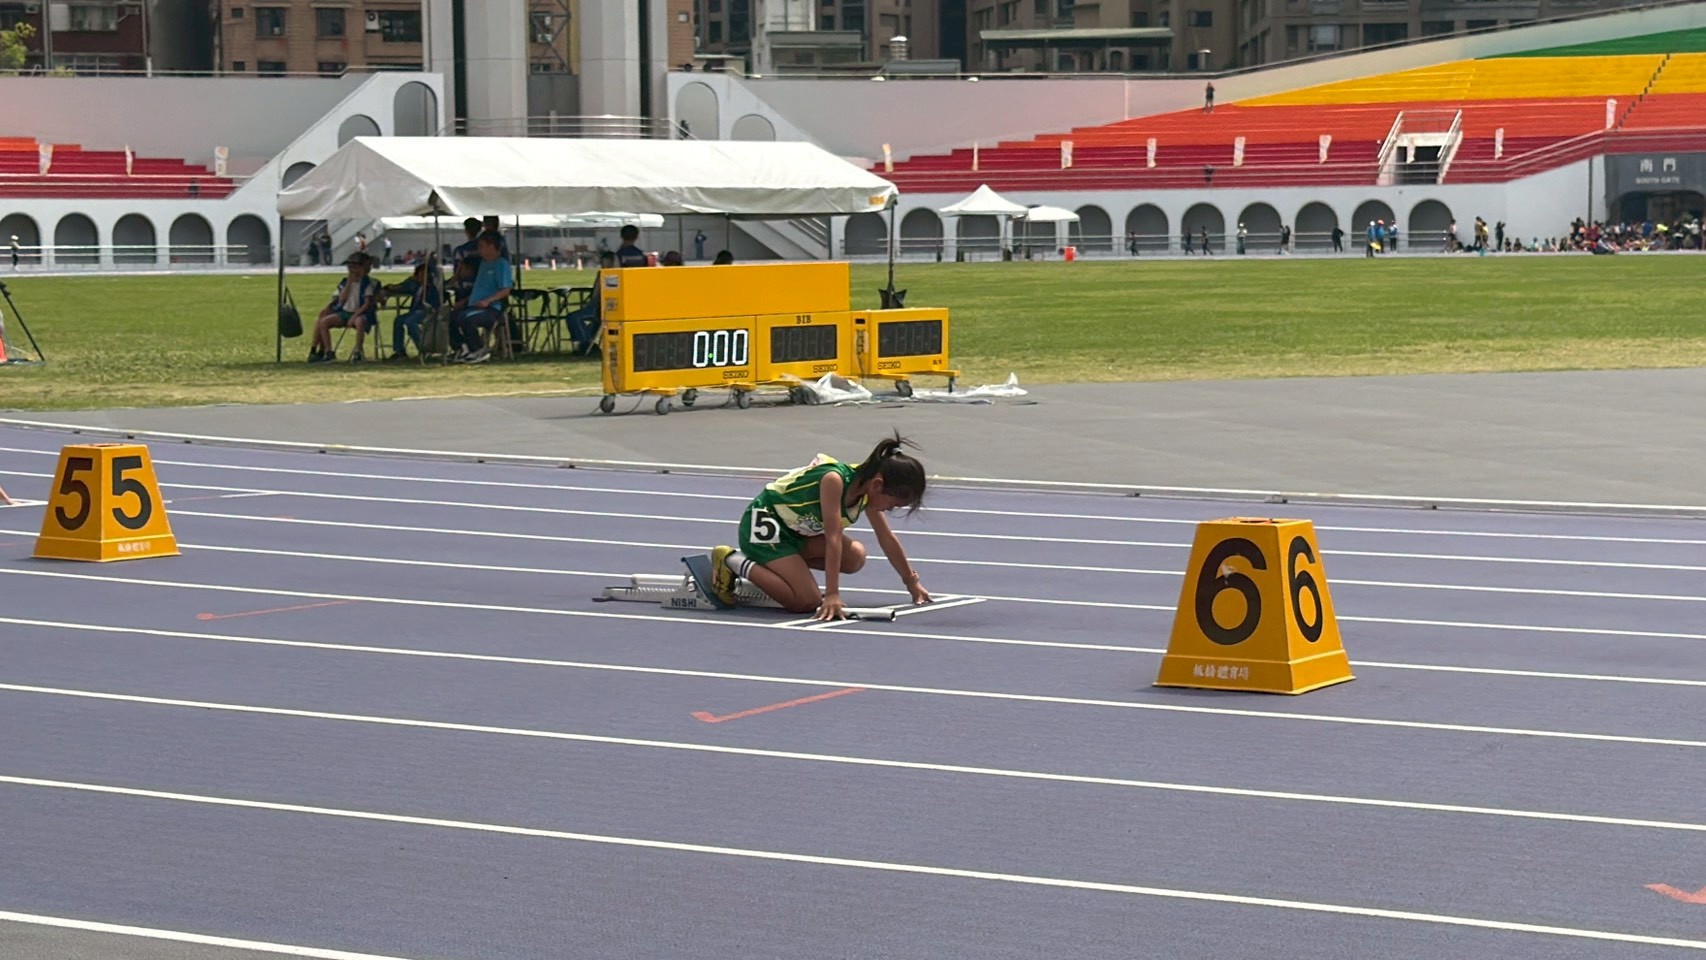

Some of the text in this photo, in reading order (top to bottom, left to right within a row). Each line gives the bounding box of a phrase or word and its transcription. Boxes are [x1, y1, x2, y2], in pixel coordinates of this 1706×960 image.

[796, 315, 812, 324] BIB
[722, 370, 749, 379] SEIKO
[813, 364, 838, 373] SEIKO
[878, 361, 901, 370] SEIKO
[55, 457, 93, 531] 5
[112, 455, 152, 530] 5
[754, 511, 776, 541] 5
[1195, 537, 1267, 646] 6
[1288, 535, 1323, 643] 6
[671, 597, 697, 607] NISHI
